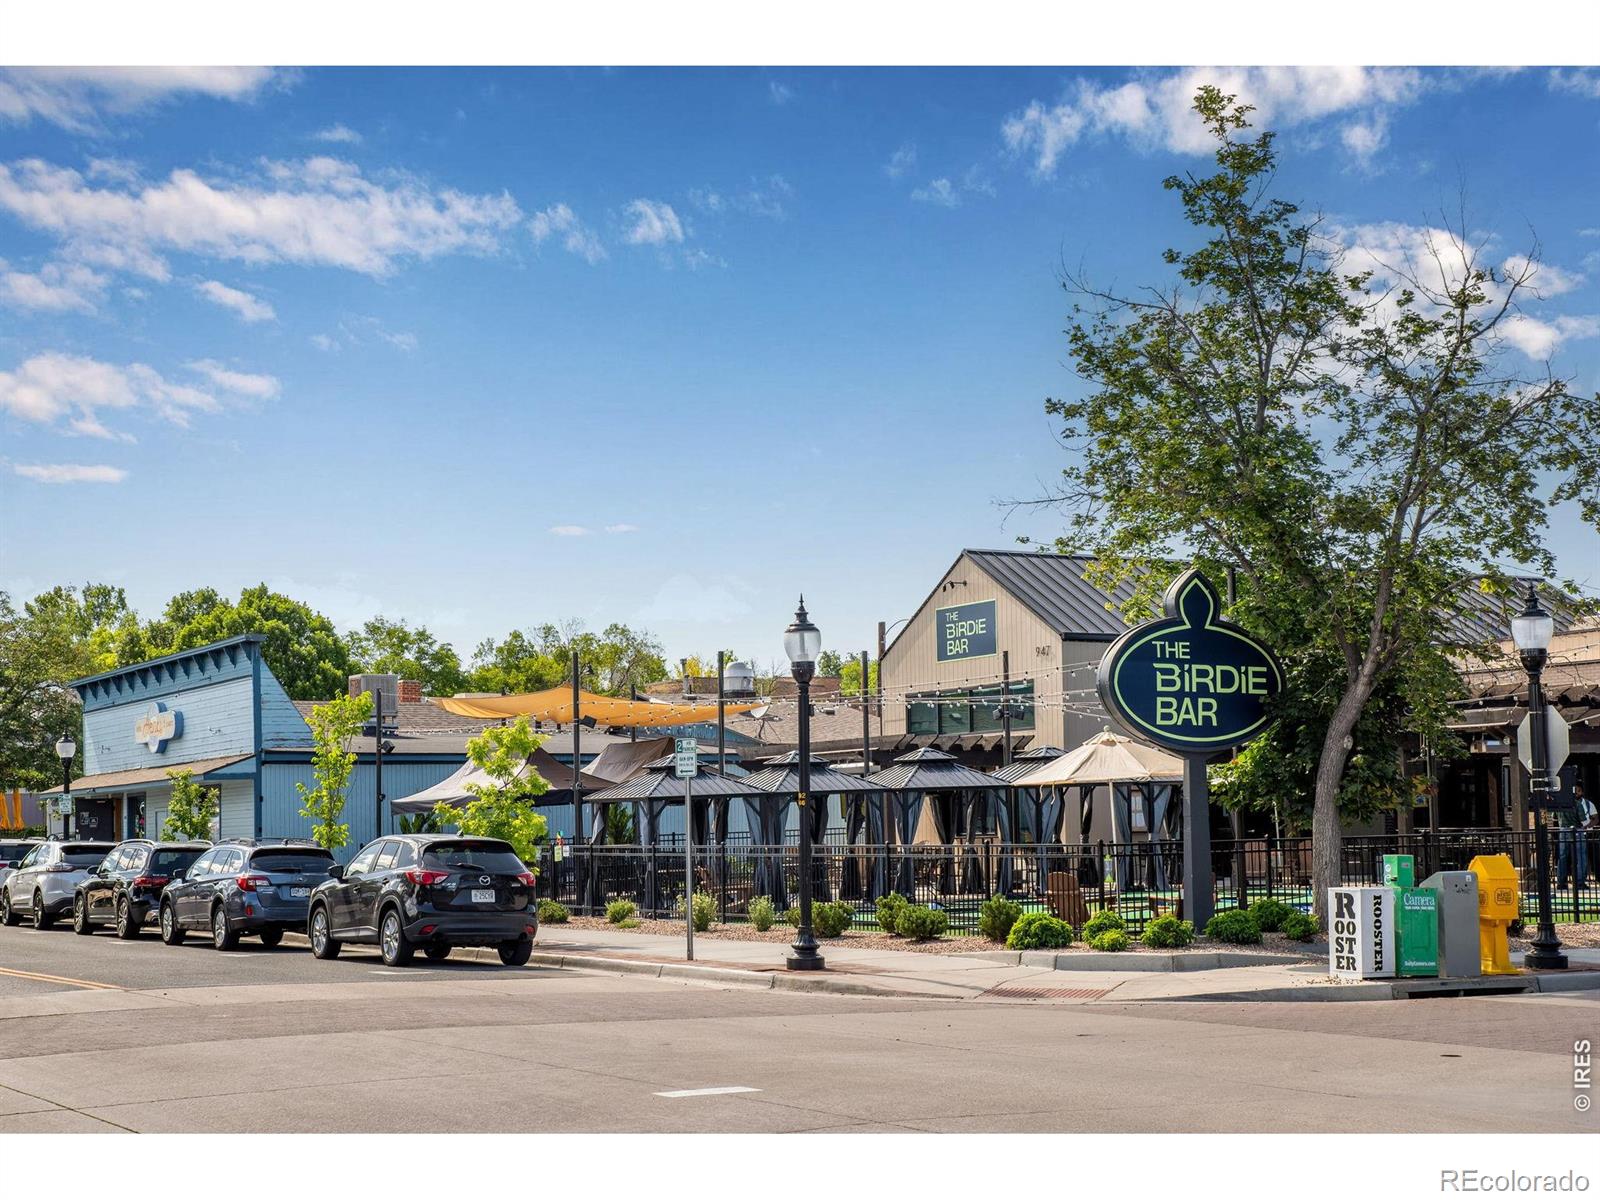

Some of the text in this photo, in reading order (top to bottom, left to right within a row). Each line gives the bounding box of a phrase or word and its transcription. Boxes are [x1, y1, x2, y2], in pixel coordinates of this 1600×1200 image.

[946, 611, 958, 622] THE
[947, 638, 968, 656] BAR
[1035, 645, 1052, 657] 947
[1152, 641, 1190, 659] THE
[1156, 697, 1218, 726] BAR
[677, 741, 682, 752] 2
[1404, 892, 1436, 906] Camera
[1373, 894, 1383, 972] ROOSTER
